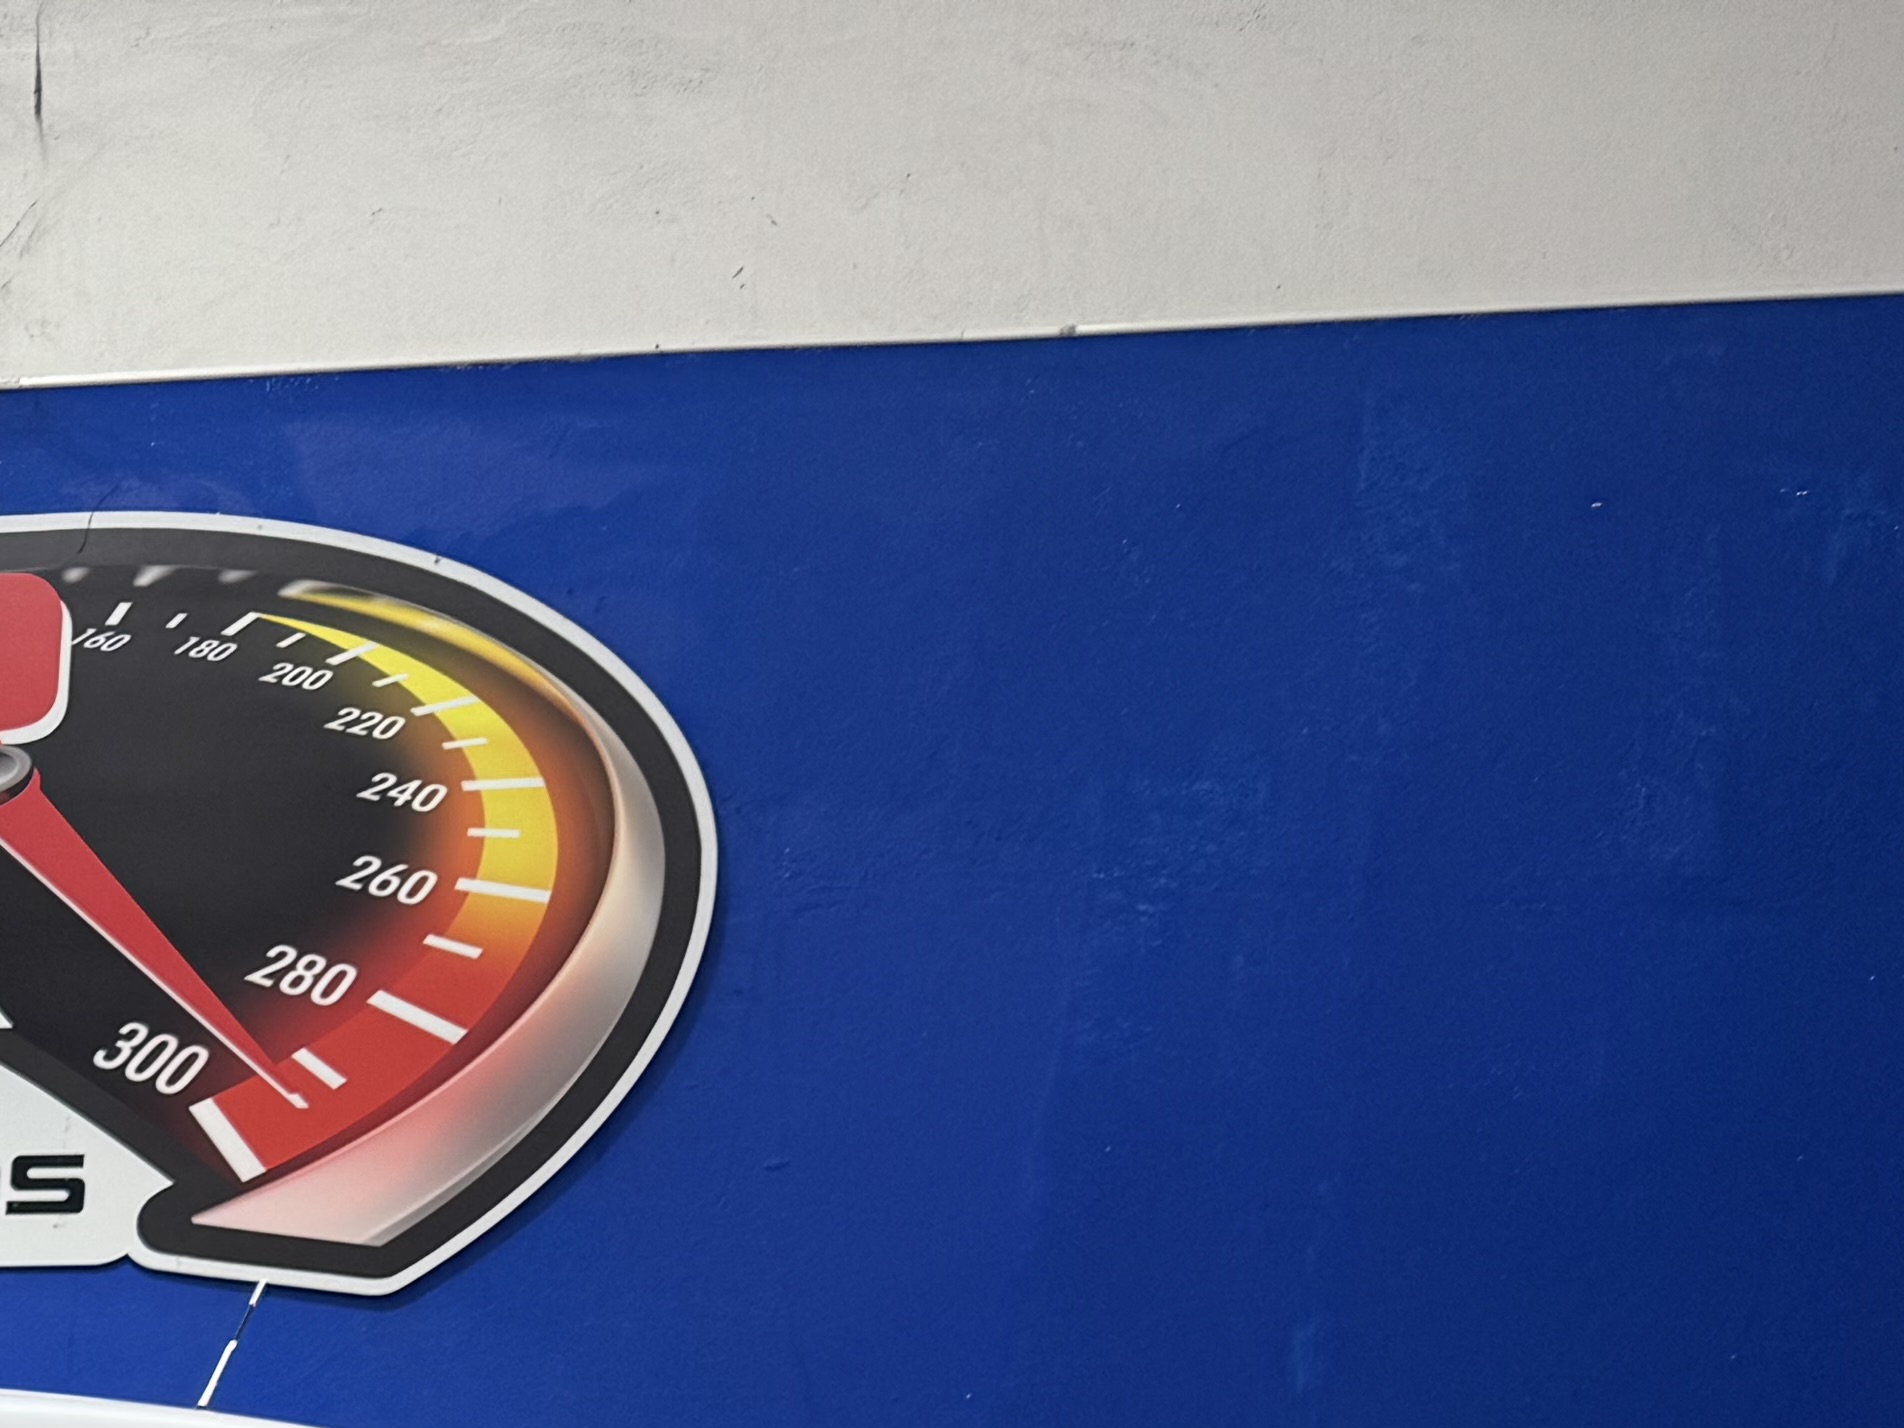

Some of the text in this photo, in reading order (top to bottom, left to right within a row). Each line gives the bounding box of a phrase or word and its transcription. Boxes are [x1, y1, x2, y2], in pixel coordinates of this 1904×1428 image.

[71, 627, 132, 652] 160
[174, 636, 238, 662] 180
[258, 662, 333, 690] 200
[323, 707, 406, 739] 220
[356, 772, 448, 812] 240
[335, 855, 438, 905] 260
[244, 944, 358, 1006] 280
[93, 1021, 210, 1095] 300
